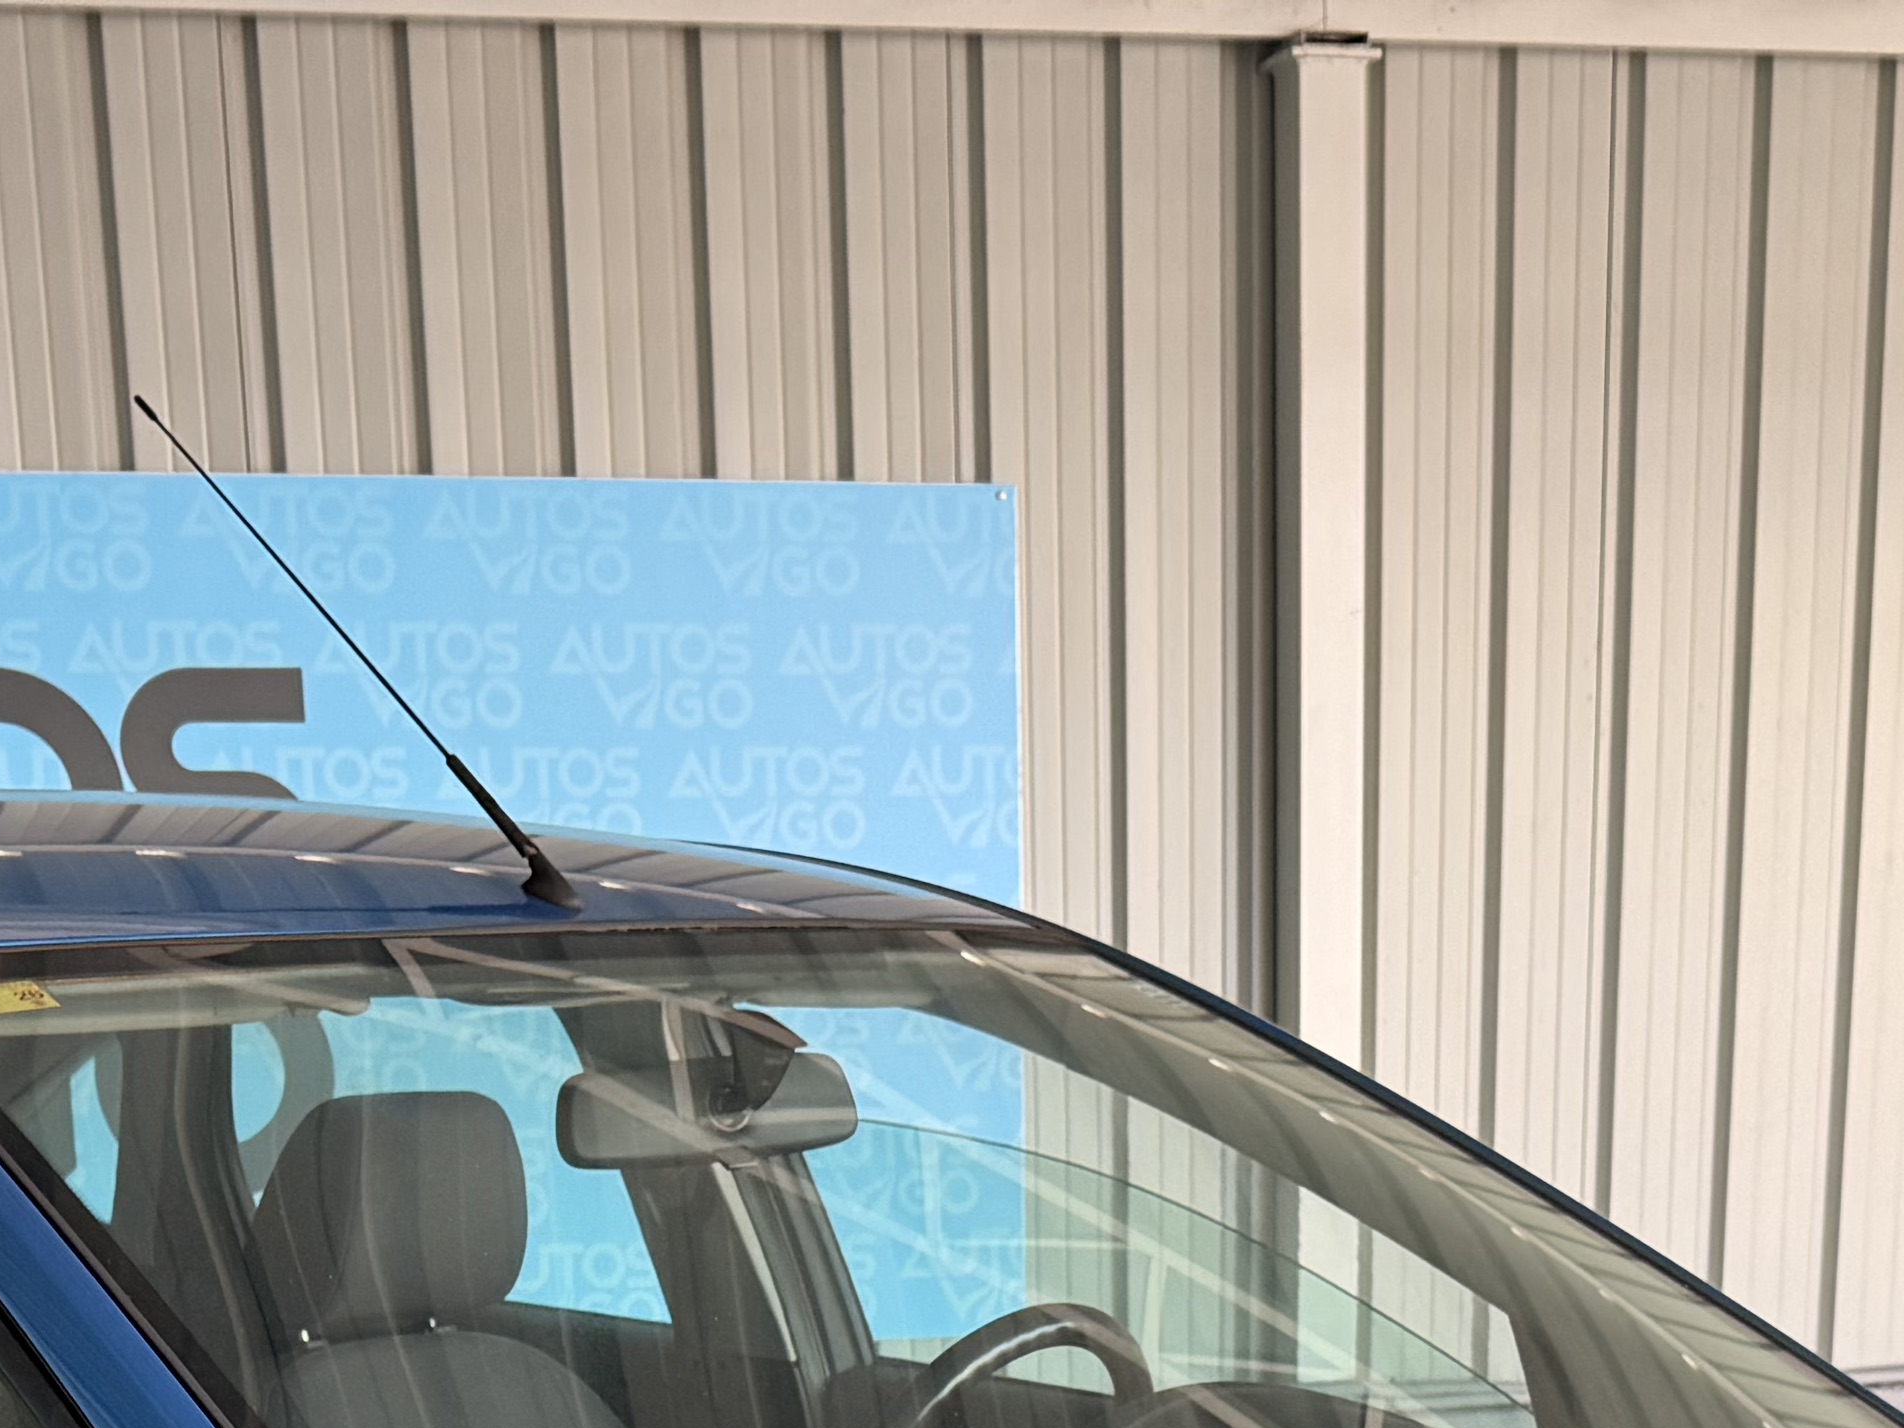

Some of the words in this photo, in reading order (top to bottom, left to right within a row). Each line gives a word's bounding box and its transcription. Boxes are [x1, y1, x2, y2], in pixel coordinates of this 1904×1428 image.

[178, 484, 392, 541] AUTOS
[423, 487, 629, 542] AUTOS
[660, 489, 858, 544] AUTOS
[886, 490, 1014, 545] AUT
[70, 621, 282, 673] AUTOS
[314, 620, 520, 675] AUTOS
[550, 622, 752, 675] AUTOS
[781, 624, 971, 675] AUTOS
[676, 745, 865, 797] AUTOS
